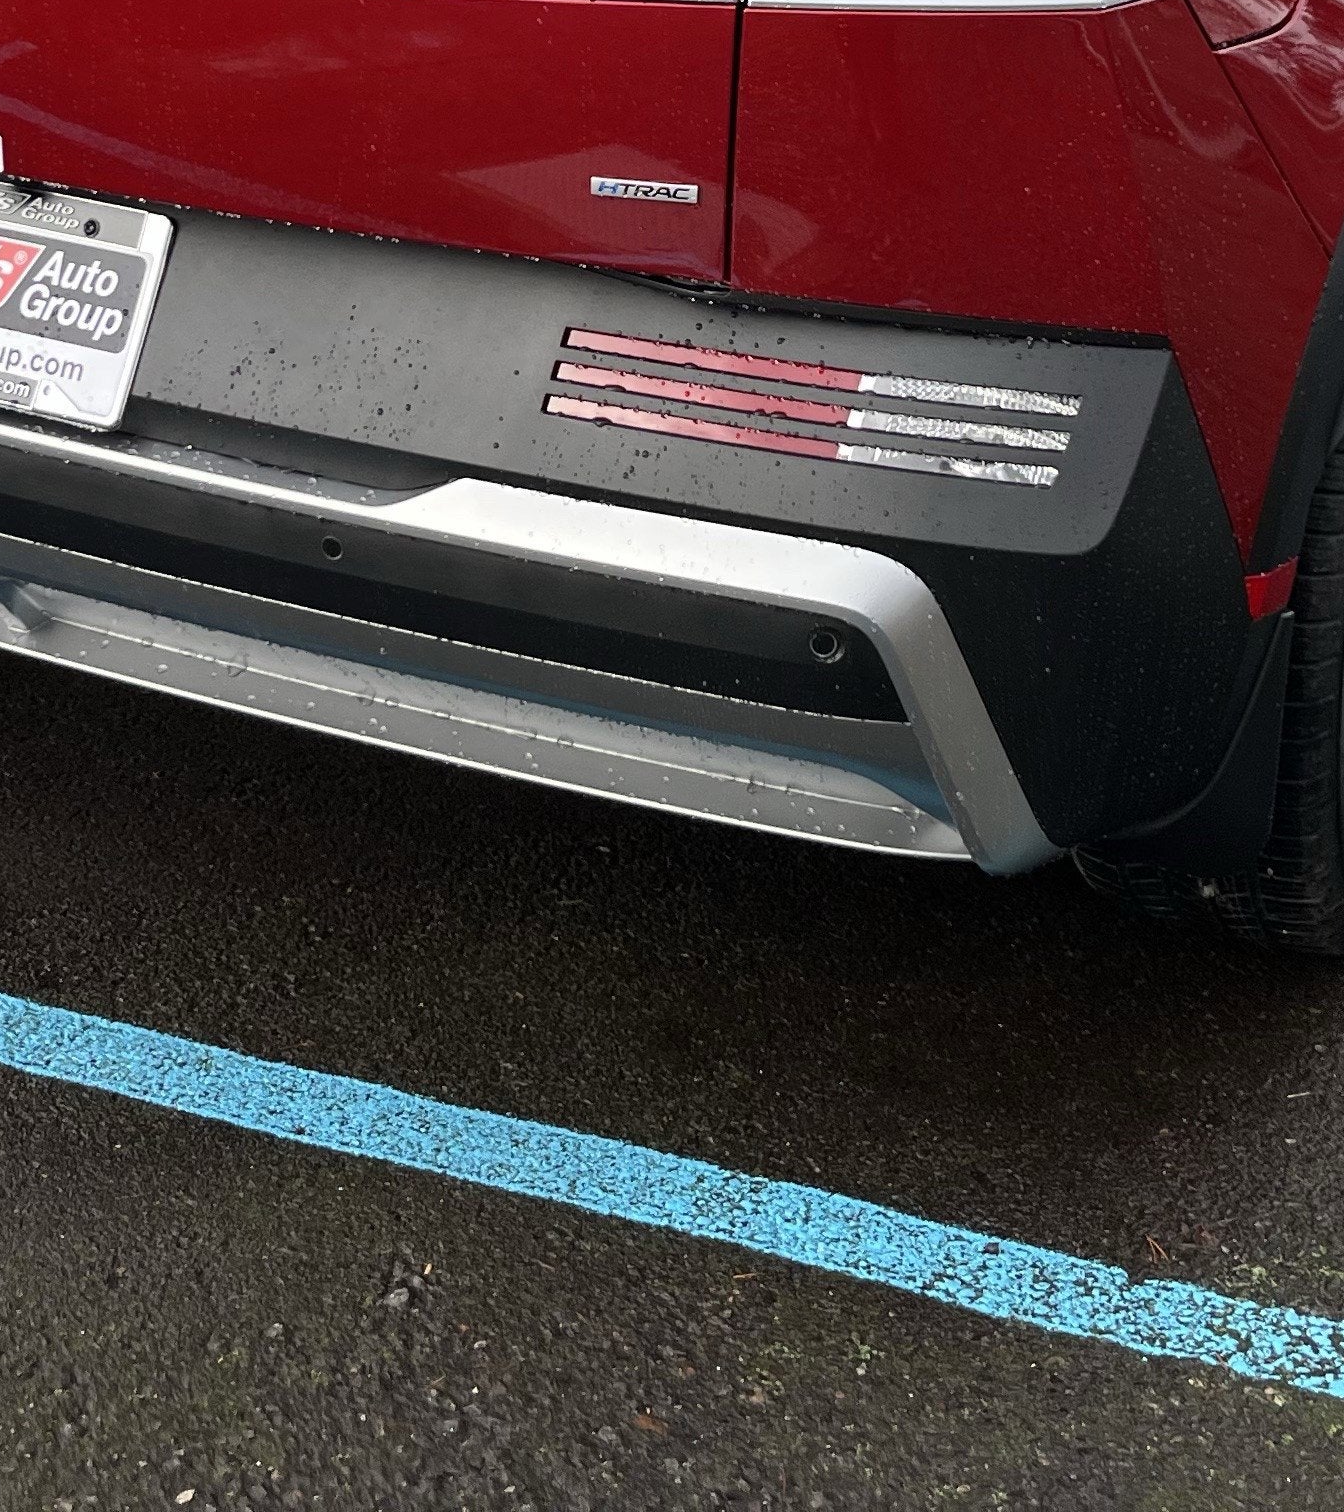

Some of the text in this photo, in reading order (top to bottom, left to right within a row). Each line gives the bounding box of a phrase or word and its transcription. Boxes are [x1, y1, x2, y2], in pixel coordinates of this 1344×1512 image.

[598, 181, 690, 200] HTRAC
[30, 196, 75, 216] Auto
[21, 207, 80, 230] Group
[34, 250, 119, 297] Auto
[19, 283, 123, 341] Group
